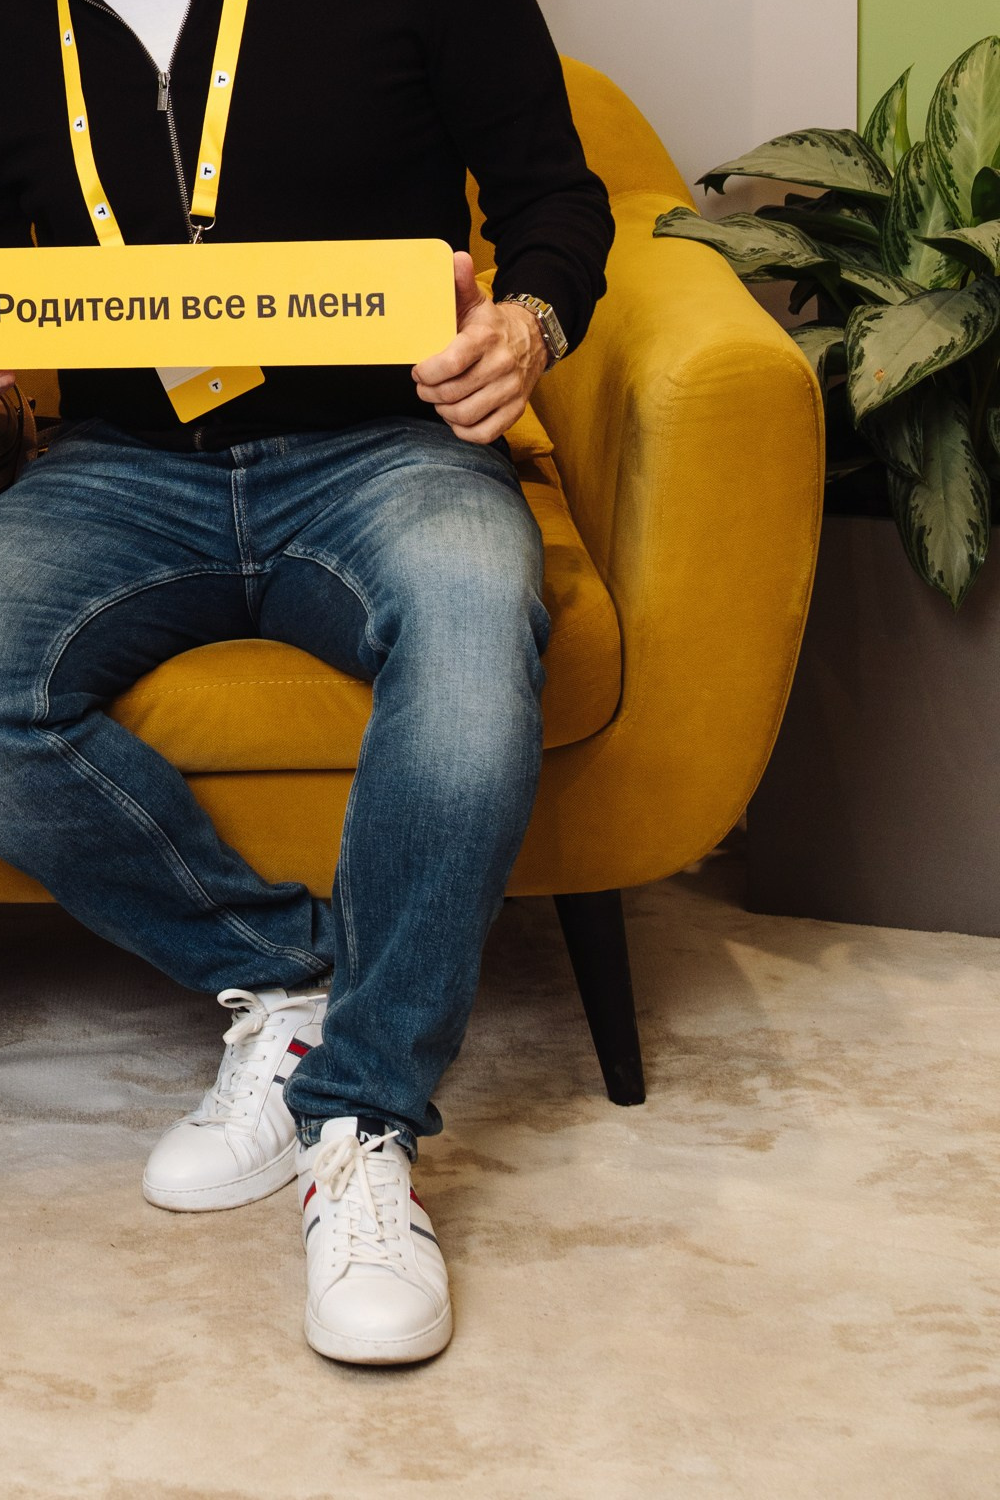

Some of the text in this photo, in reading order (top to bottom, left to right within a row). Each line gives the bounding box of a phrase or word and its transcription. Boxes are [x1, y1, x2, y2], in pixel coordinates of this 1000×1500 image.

[181, 294, 246, 320] все
[256, 294, 277, 319] в
[287, 292, 386, 318] меня
